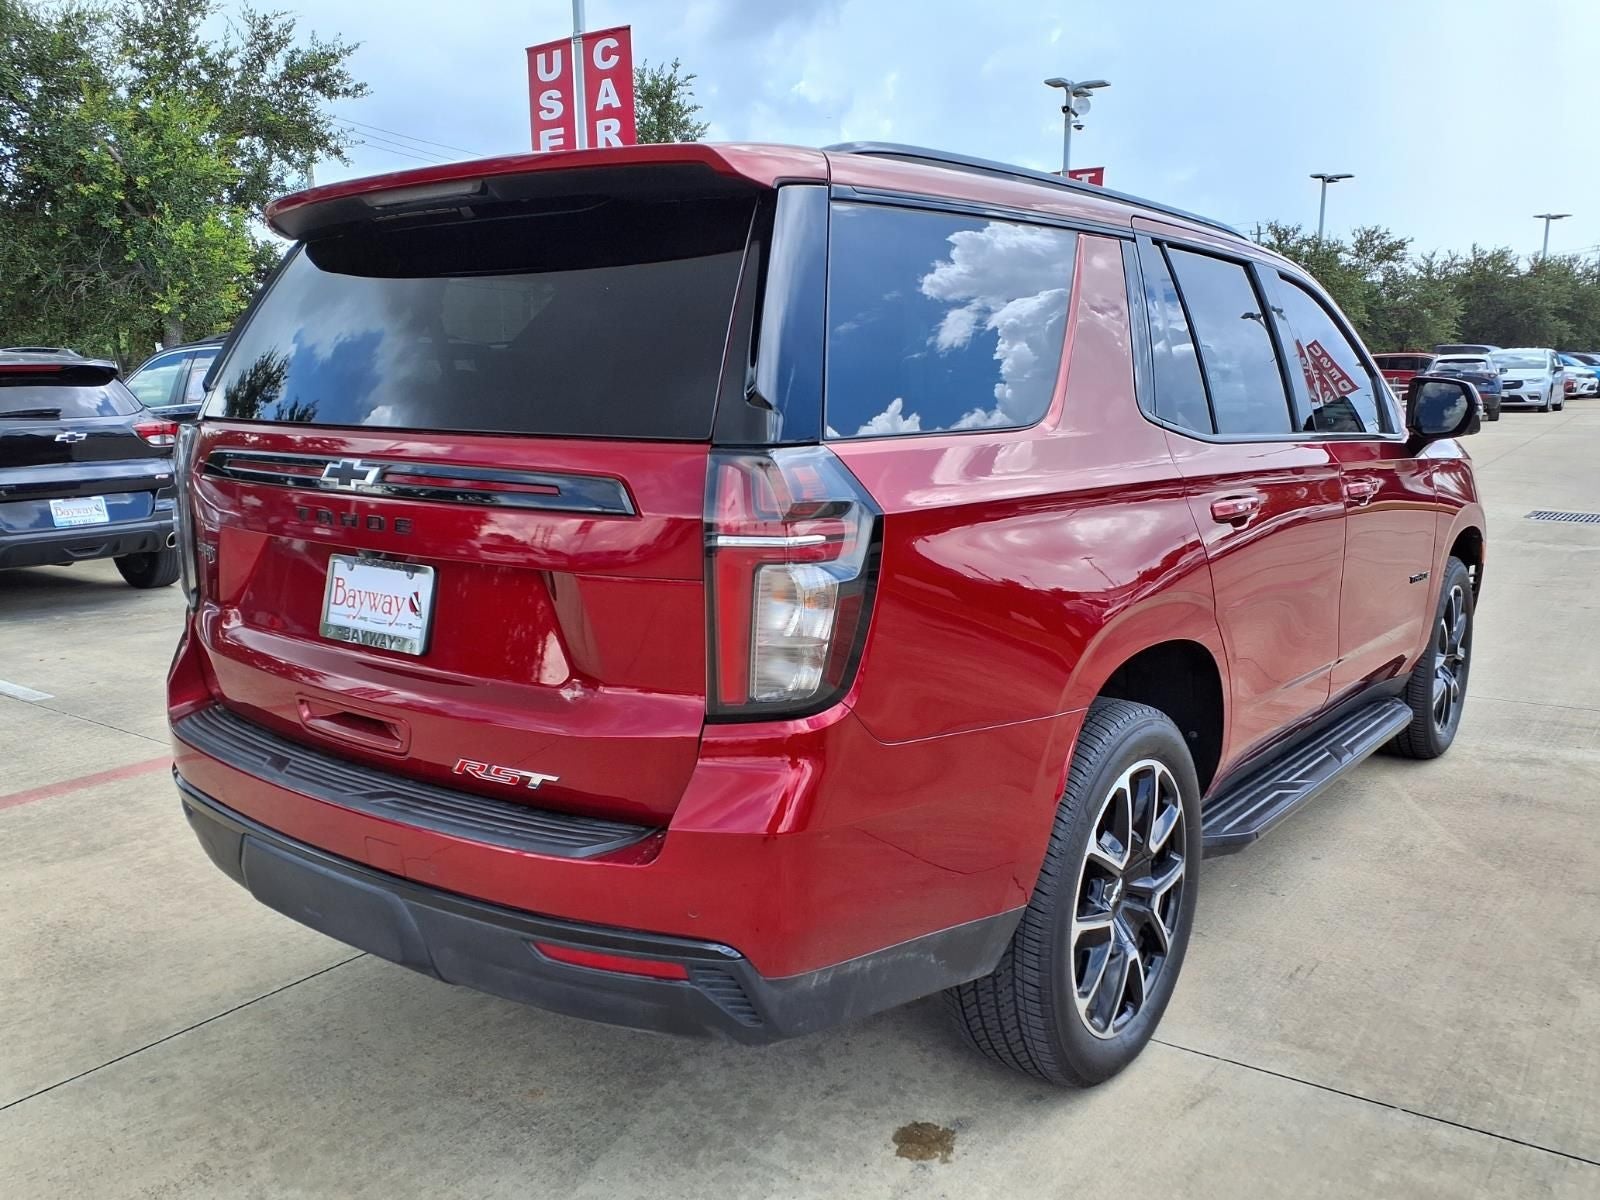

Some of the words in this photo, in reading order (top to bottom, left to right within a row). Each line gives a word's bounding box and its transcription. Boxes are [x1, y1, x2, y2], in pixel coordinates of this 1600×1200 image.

[296, 506, 412, 534] TAHOE
[332, 576, 406, 627] Bayway
[343, 626, 397, 649] BAYWAY
[453, 758, 560, 789] RST
